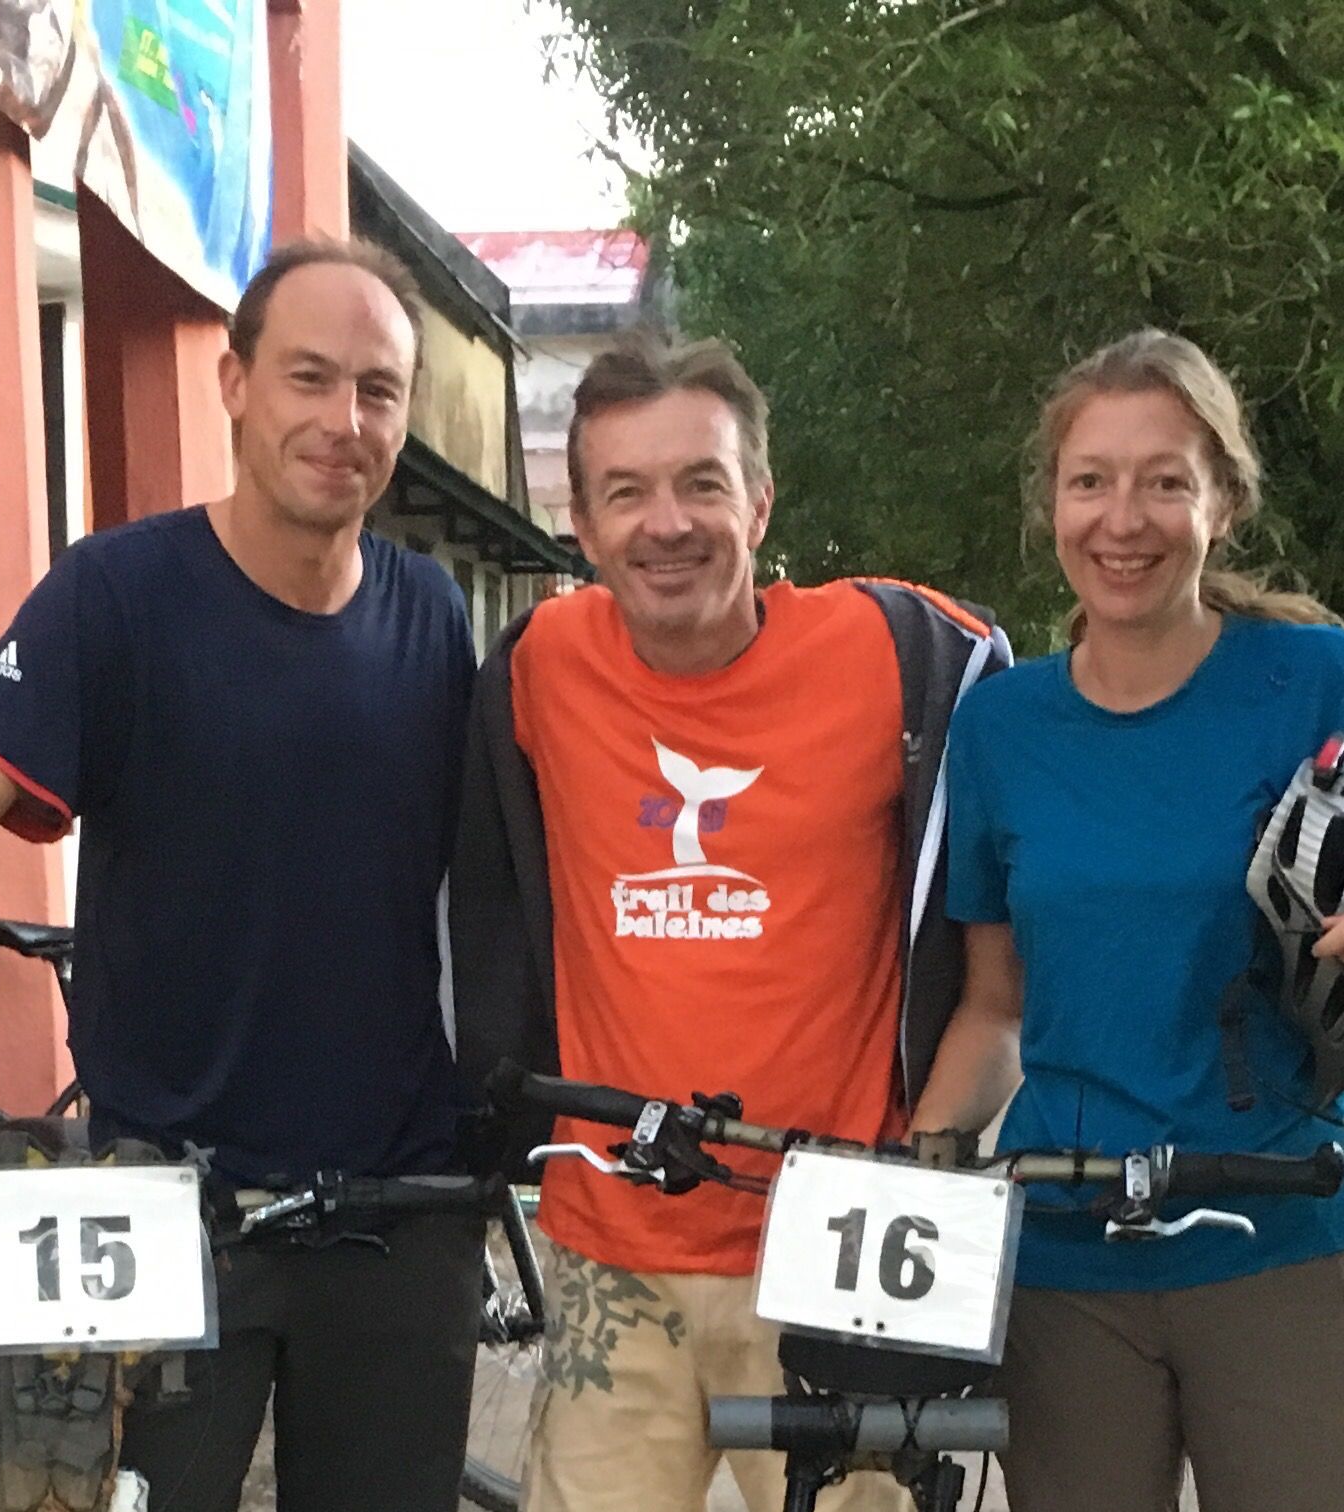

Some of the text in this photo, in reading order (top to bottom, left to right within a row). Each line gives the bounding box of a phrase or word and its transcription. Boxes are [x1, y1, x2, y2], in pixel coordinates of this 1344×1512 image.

[610, 880, 771, 912] trail des
[615, 910, 763, 939] baleines
[18, 1215, 136, 1301] 15
[826, 1206, 939, 1301] 16
